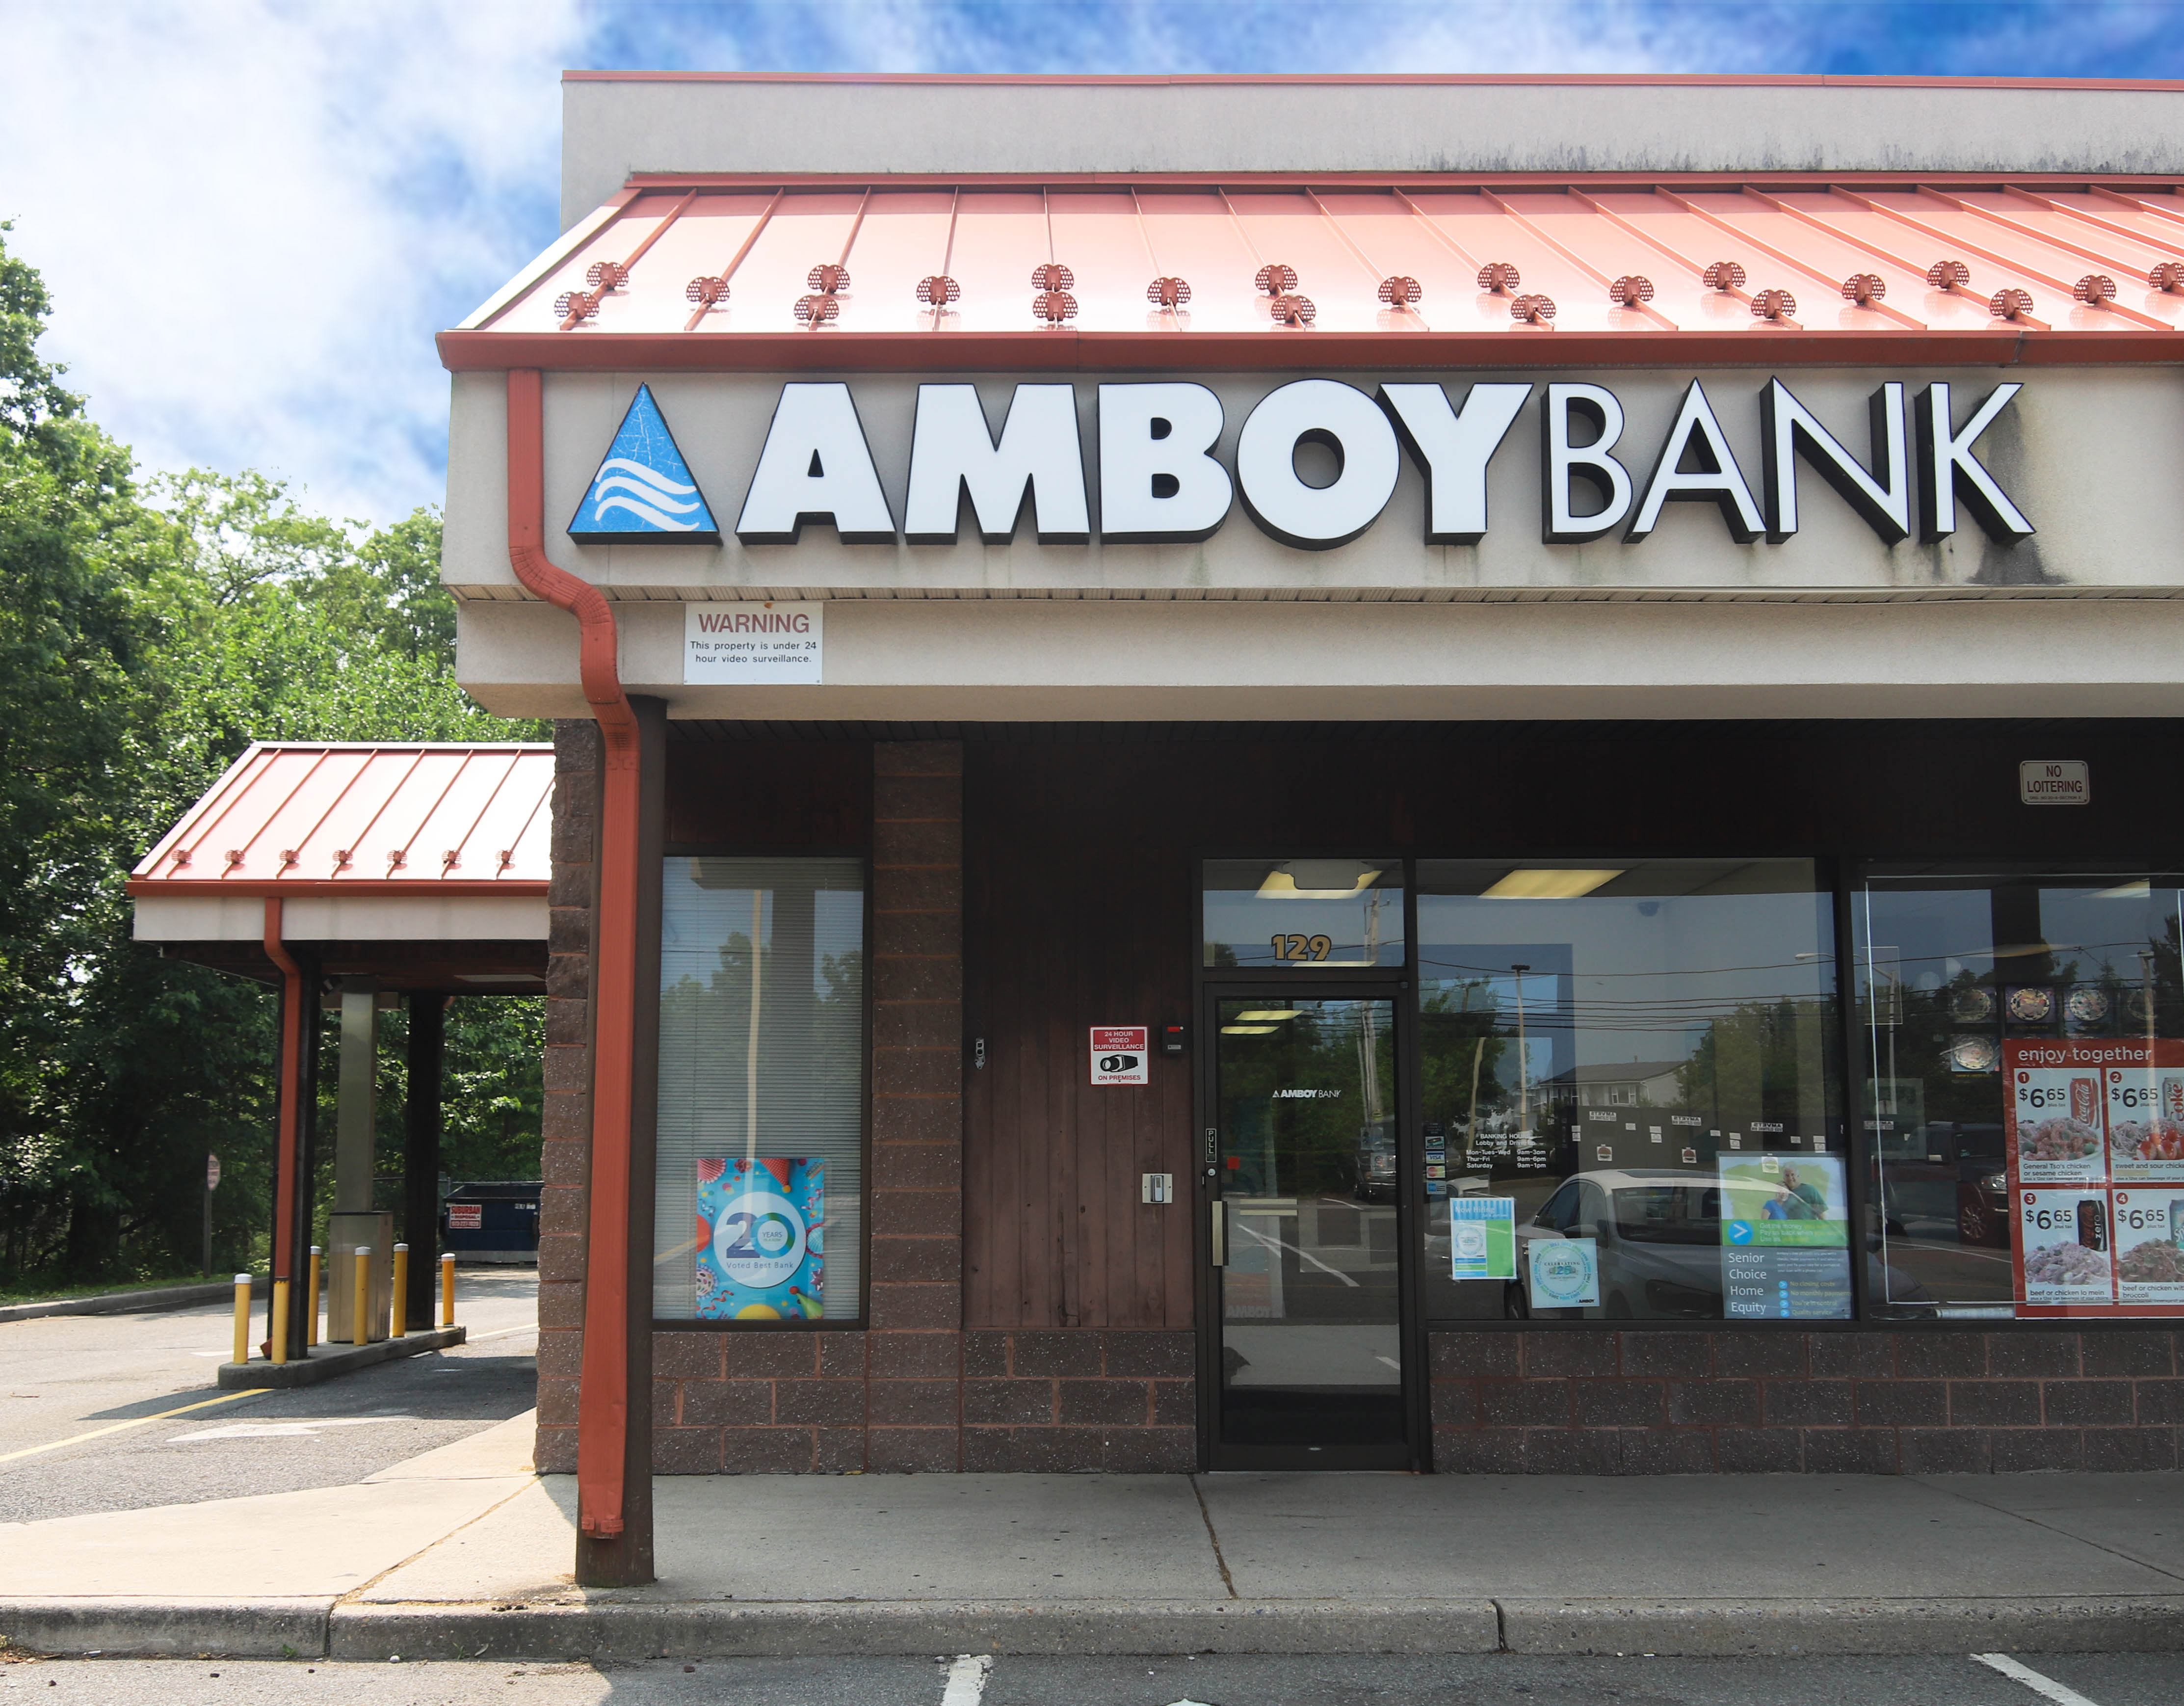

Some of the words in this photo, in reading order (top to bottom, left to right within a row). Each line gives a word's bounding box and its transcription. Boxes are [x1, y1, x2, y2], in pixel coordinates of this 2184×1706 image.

[698, 613, 809, 633] WARNING
[690, 641, 710, 649] This
[714, 641, 756, 651] property
[805, 641, 816, 649] 24
[695, 654, 716, 663] hour
[752, 654, 812, 663] surveillance.
[2046, 765, 2062, 777] NO
[2027, 780, 2082, 793] LOITERING
[1271, 934, 1332, 961] 129
[2018, 1047, 2066, 1064] enjoy
[2072, 1046, 2152, 1064] together
[1280, 1090, 1318, 1098] AMBOY
[1318, 1090, 1342, 1098] BANK
[451, 1206, 480, 1214] SUBURBAN
[726, 1212, 796, 1259] 20
[1728, 1253, 1765, 1262] Senior
[1729, 1269, 1767, 1279] Choice
[1730, 1286, 1764, 1295] Home
[1731, 1302, 1766, 1314] Equity
